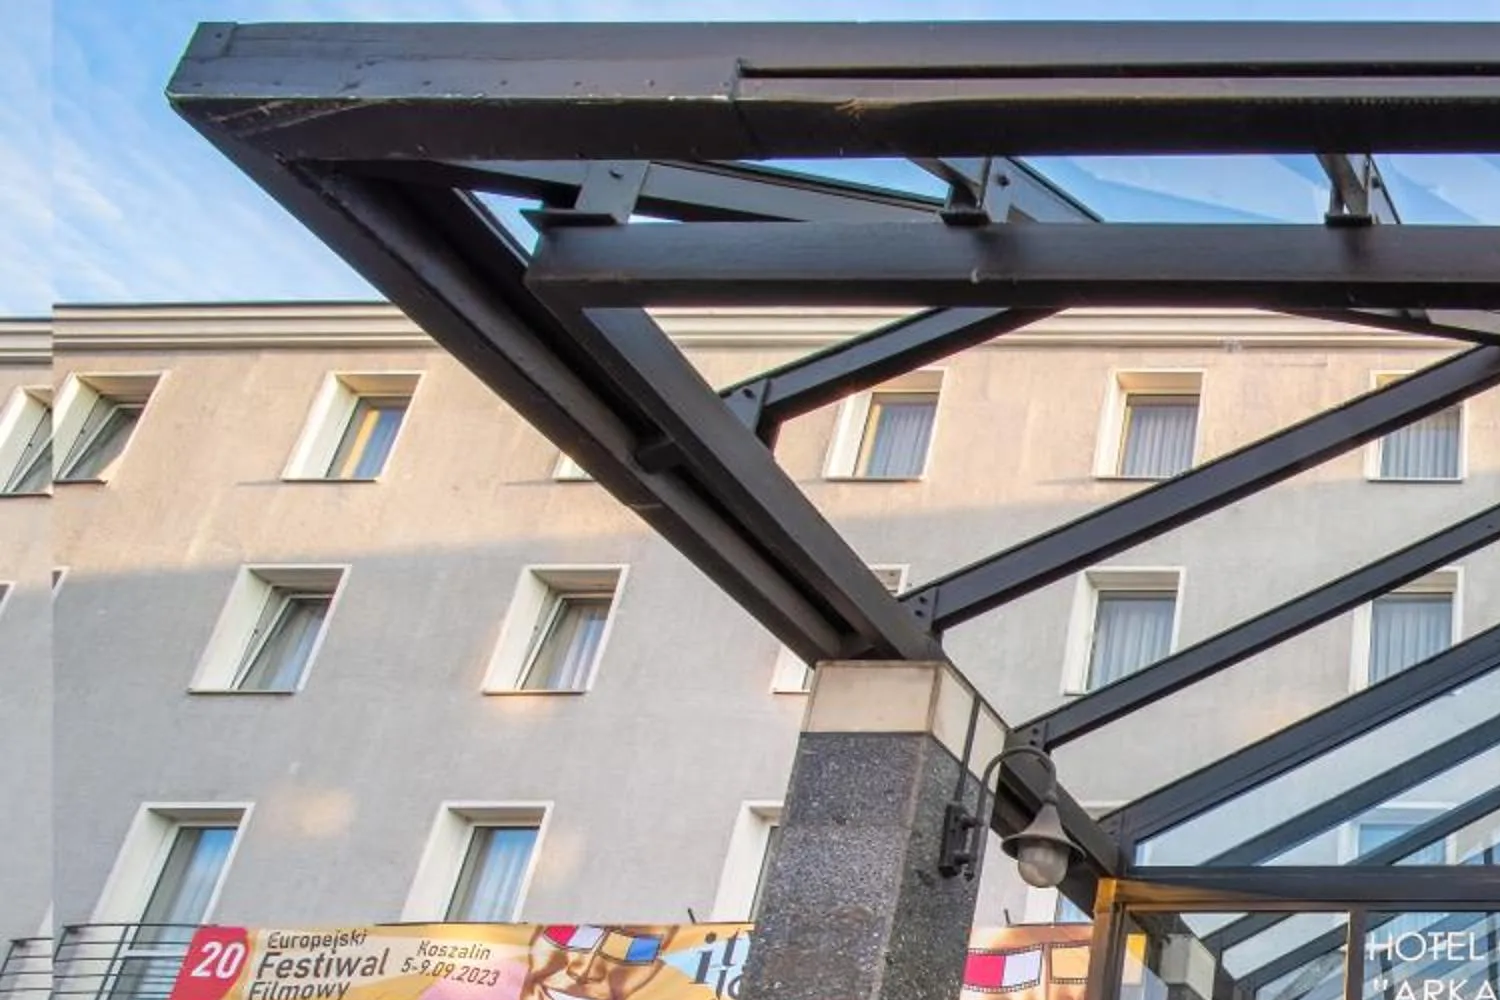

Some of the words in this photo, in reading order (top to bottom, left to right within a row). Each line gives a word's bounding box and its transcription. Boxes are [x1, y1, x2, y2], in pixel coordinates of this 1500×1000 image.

[267, 928, 368, 954] Europejski
[416, 940, 492, 961] Koszalin
[1368, 931, 1485, 961] HOTEL
[191, 941, 246, 980] 20
[256, 948, 390, 980] Festiwal
[401, 957, 501, 987] 5-9.09.2023
